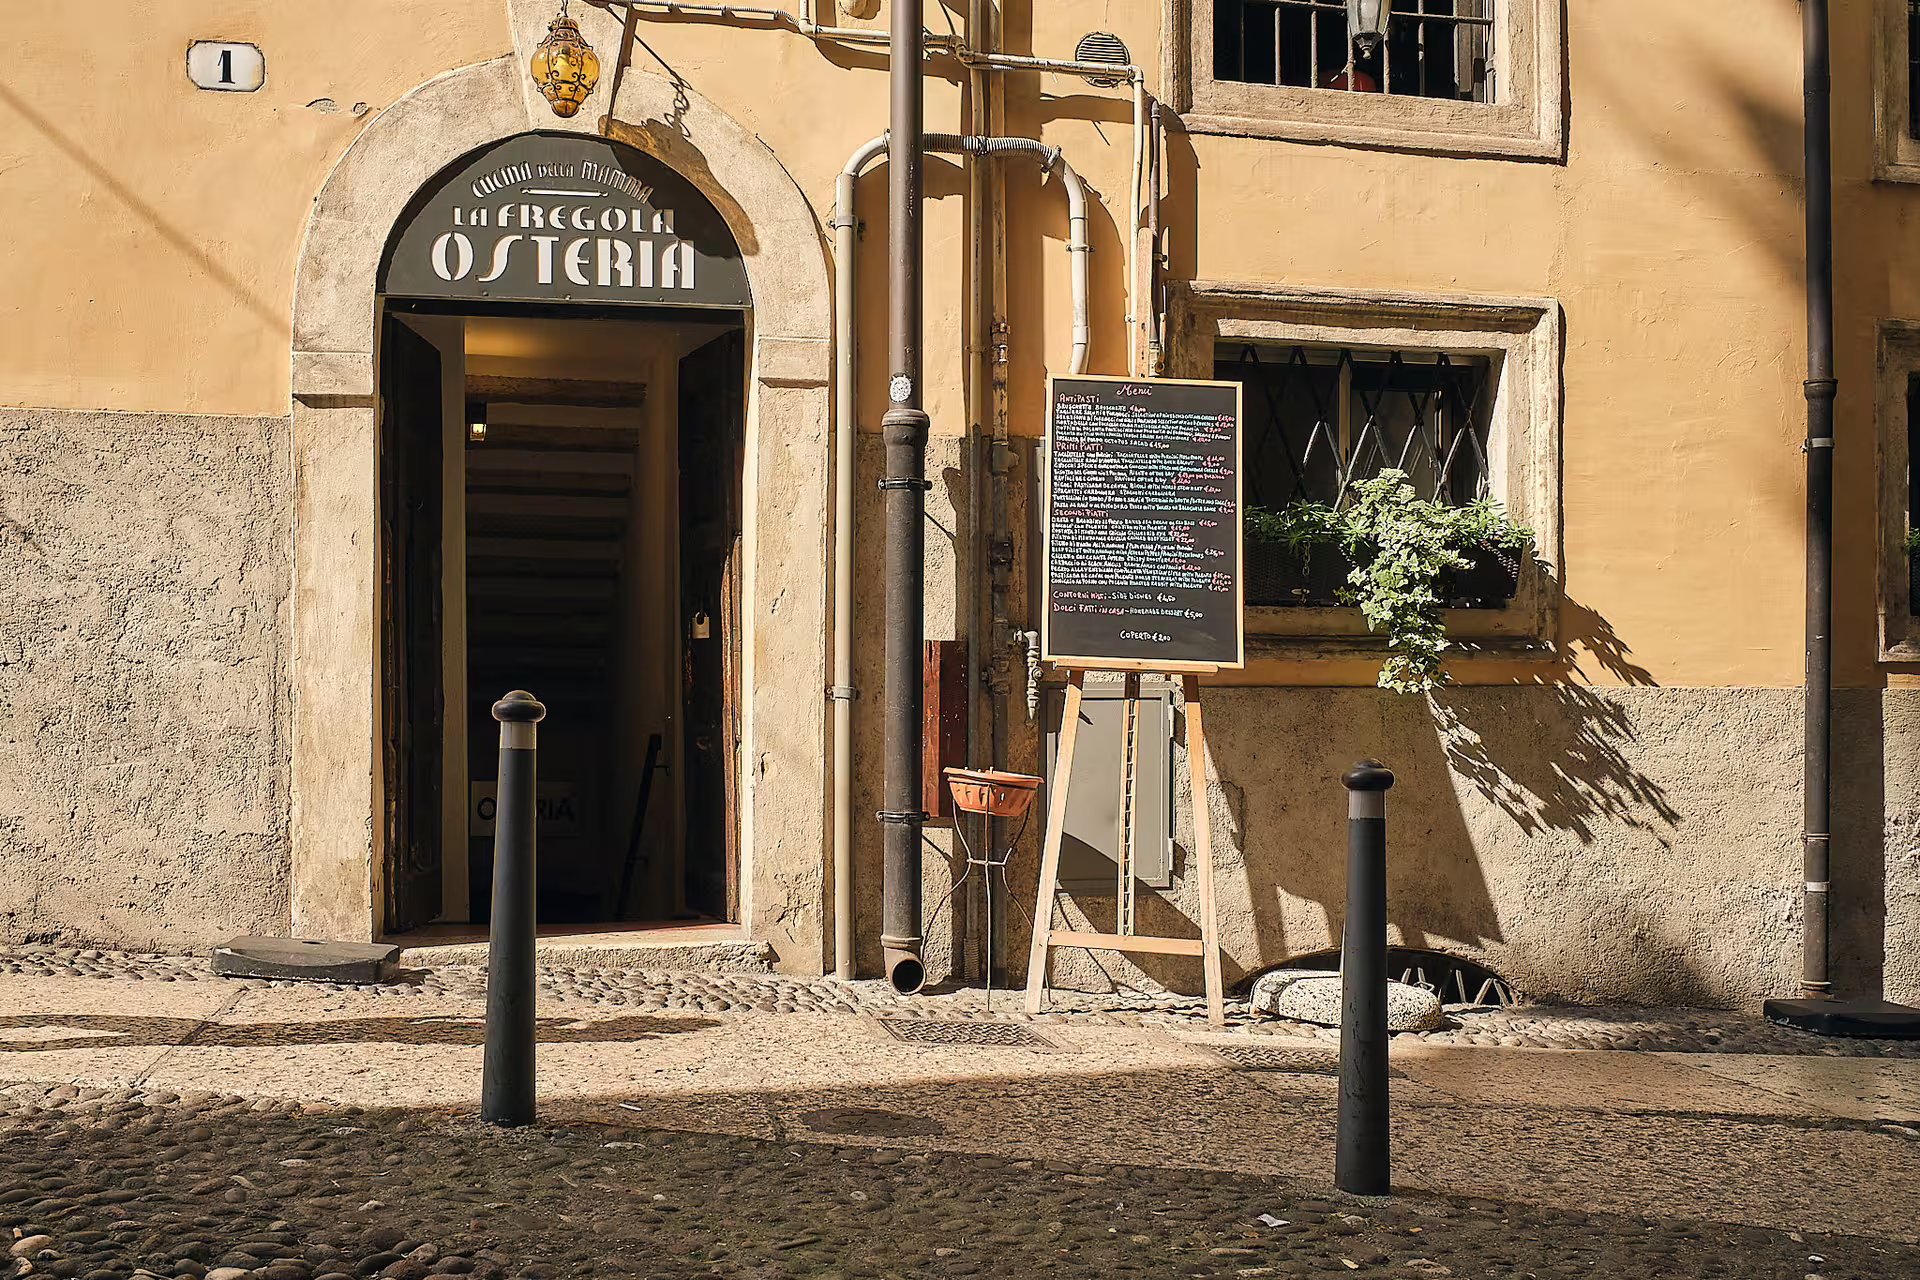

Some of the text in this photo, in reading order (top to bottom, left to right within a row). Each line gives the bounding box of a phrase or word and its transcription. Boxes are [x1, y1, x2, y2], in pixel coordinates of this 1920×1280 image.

[218, 50, 235, 84] 1
[471, 160, 655, 204] CUCINA DELLA MAMMA
[453, 203, 675, 234] LA FREGOLA
[431, 232, 695, 289] OSTERIA
[1120, 630, 1172, 642] COPERTO €2,00
